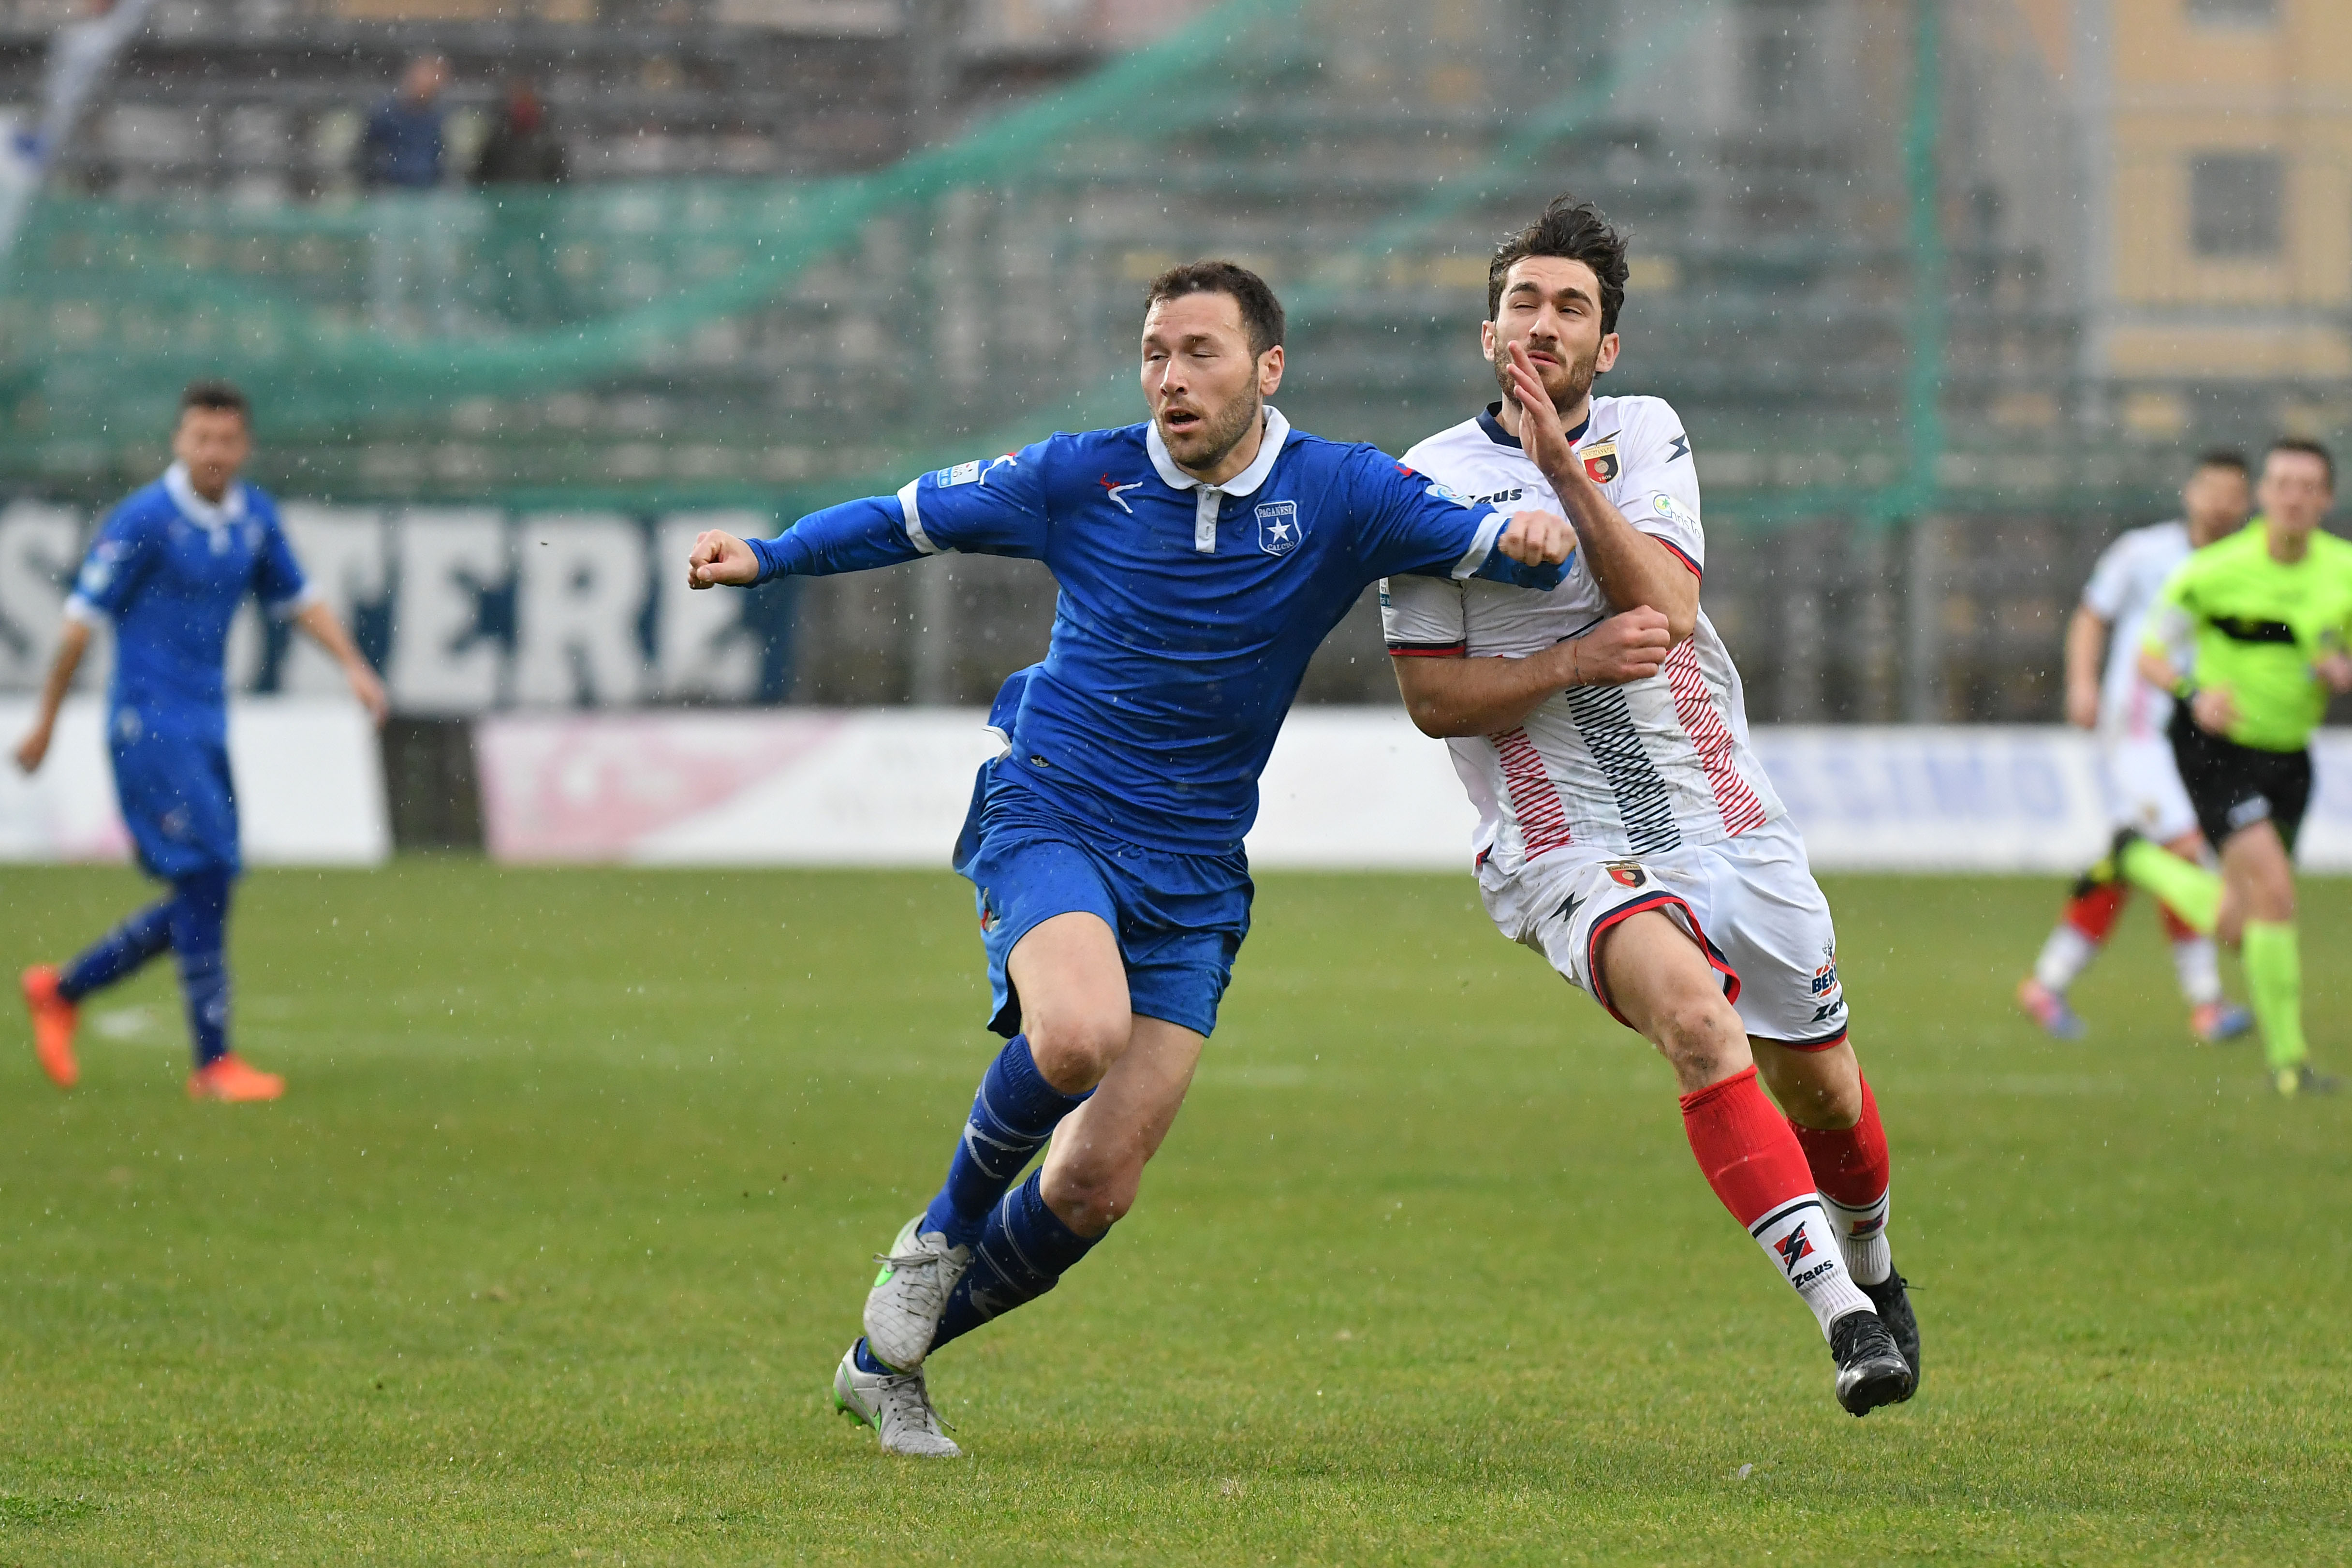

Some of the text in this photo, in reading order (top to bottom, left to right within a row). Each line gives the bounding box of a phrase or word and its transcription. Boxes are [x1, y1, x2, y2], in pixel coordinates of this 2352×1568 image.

[1468, 489, 1523, 504] eus
[1258, 505, 1293, 518] PAGANESE
[1267, 541, 1294, 551] CALCIO
[1792, 1260, 1834, 1289] Zeus
